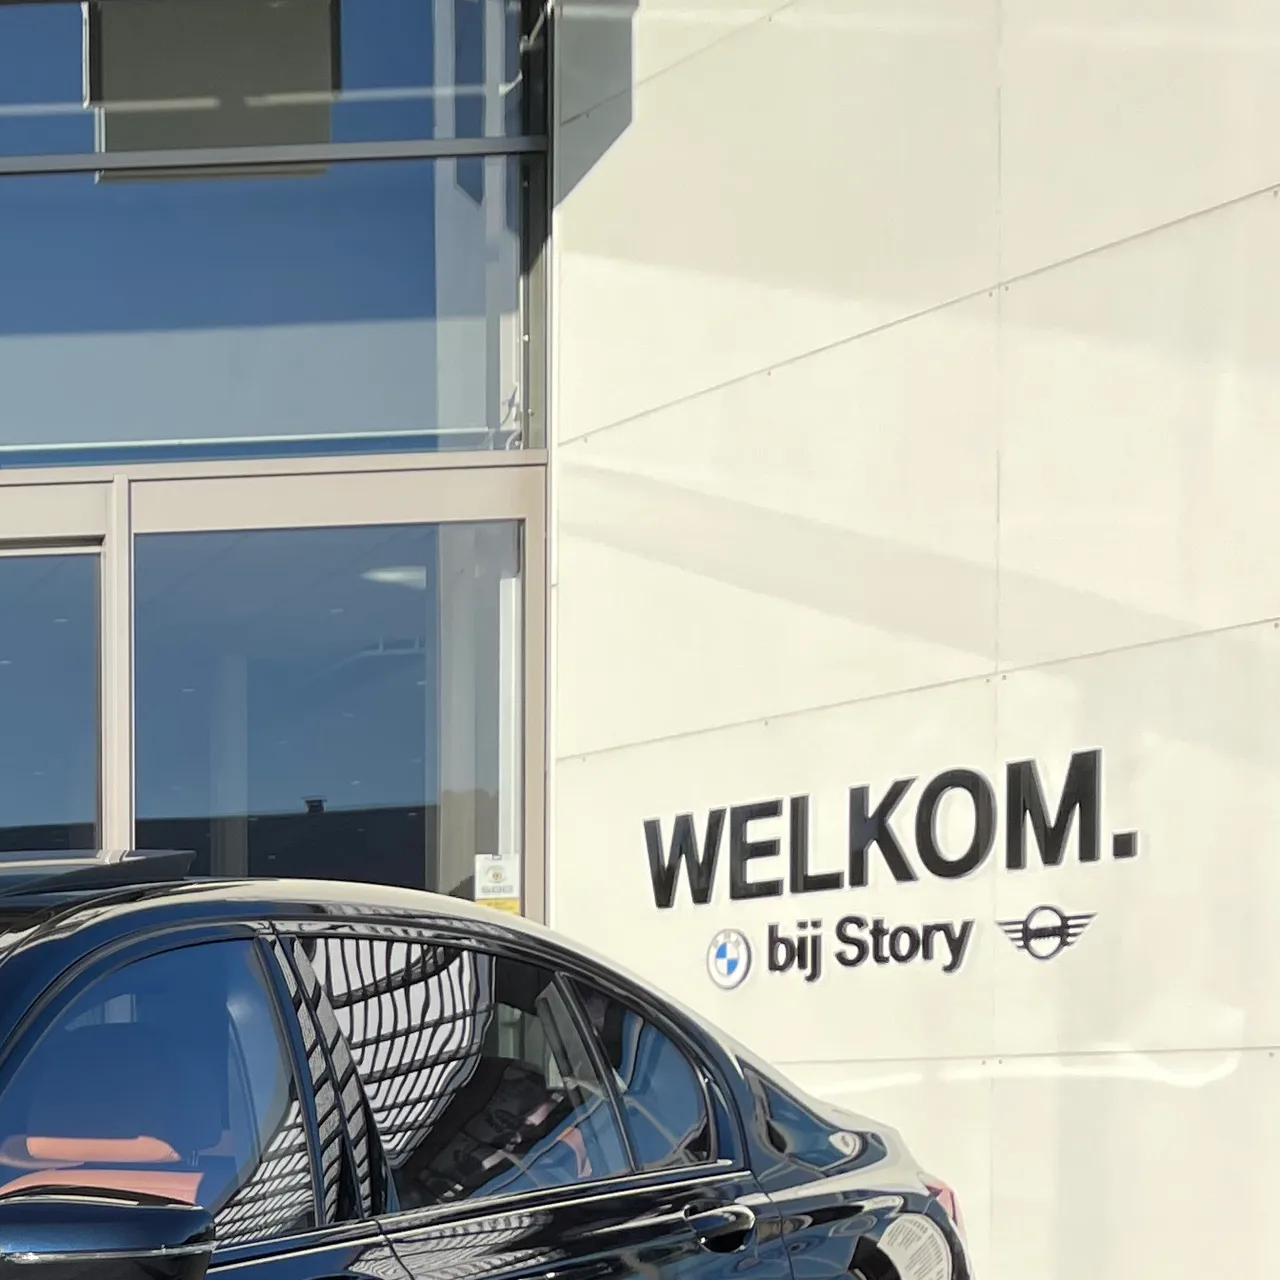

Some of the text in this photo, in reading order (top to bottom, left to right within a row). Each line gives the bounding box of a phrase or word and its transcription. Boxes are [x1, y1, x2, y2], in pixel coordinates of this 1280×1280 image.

[642, 748, 1138, 909] WELKOM.
[767, 915, 975, 982] bij Story
